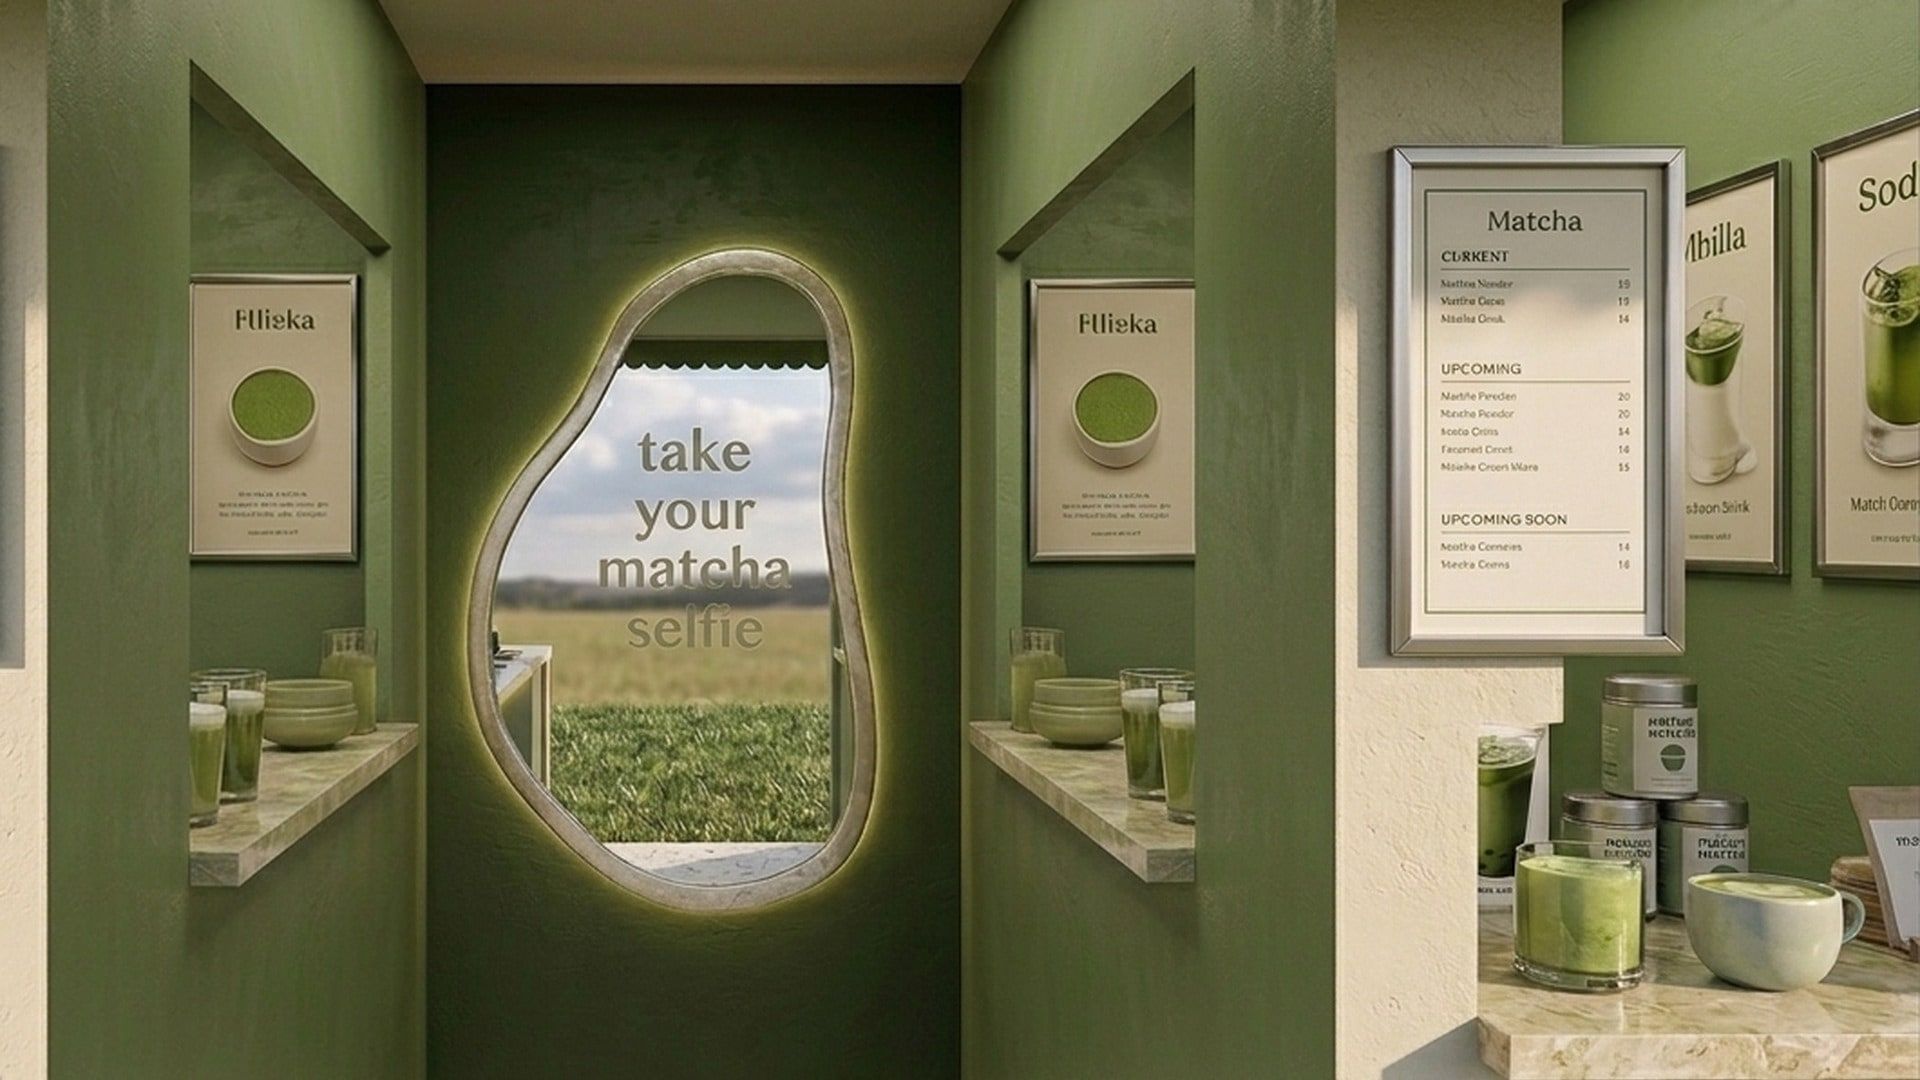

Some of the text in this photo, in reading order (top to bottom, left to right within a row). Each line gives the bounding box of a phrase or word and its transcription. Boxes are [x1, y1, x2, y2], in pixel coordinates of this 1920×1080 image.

[1859, 160, 1918, 212] Sod
[1488, 210, 1583, 231] Matcha
[1441, 363, 1521, 375] UPCOMING
[1618, 392, 1630, 401] 20
[1618, 409, 1630, 419] 20
[638, 428, 751, 471] take
[635, 499, 756, 541] your
[1441, 514, 1567, 525] UPCOMING SOON
[598, 545, 792, 588] matcha
[627, 603, 763, 648] selfie
